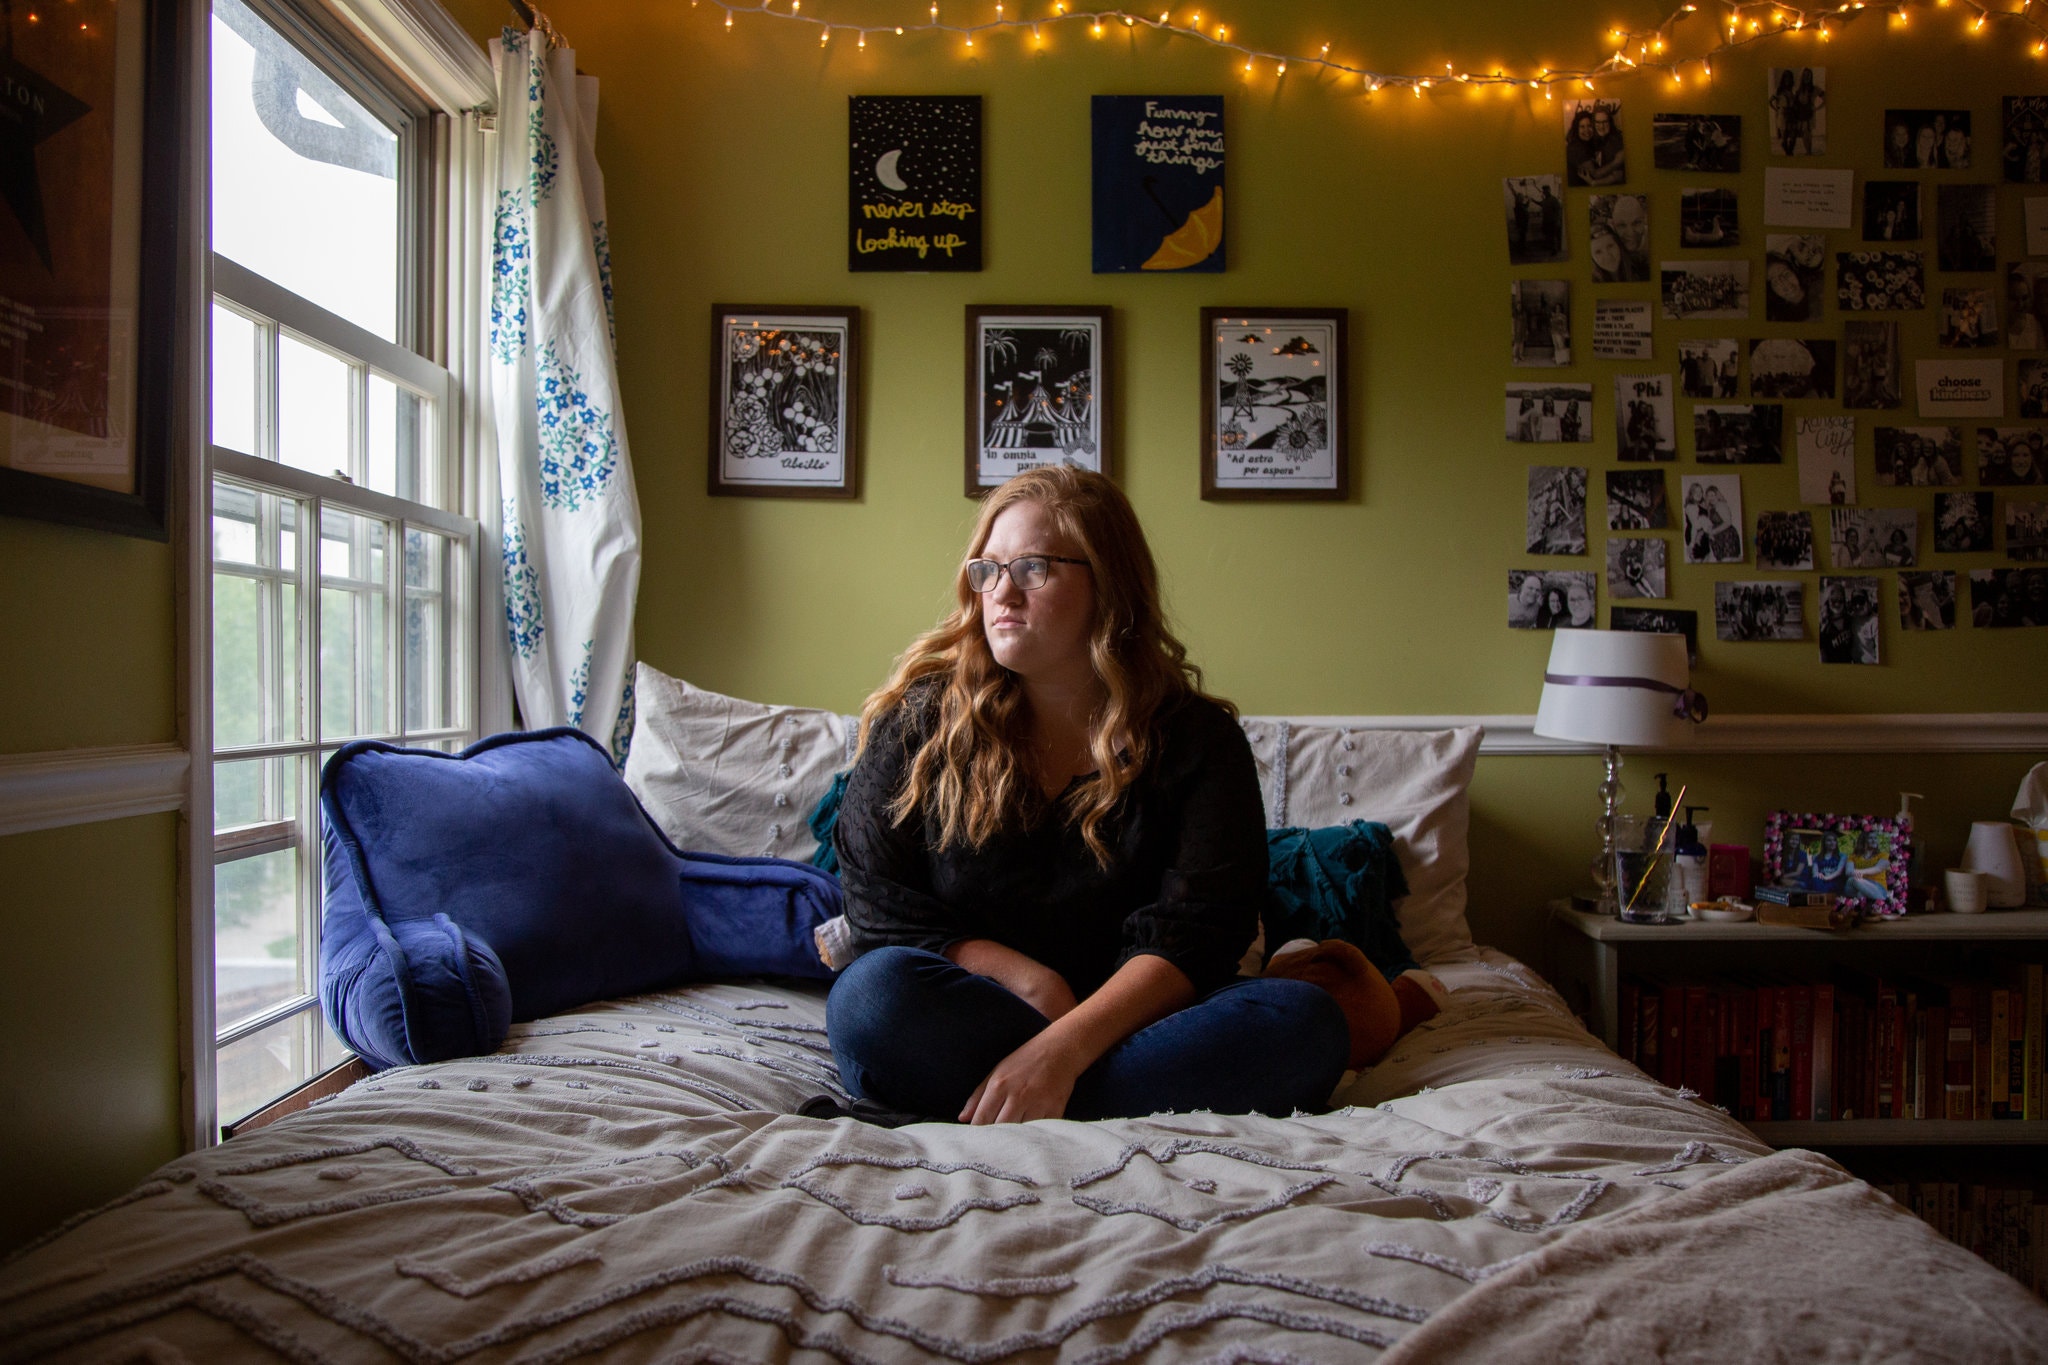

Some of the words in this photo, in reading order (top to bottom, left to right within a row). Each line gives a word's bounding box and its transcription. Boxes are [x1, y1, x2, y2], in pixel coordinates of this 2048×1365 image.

[1145, 101, 1218, 127] Funny
[1136, 121, 1185, 139] how
[1185, 127, 1223, 143] you
[1133, 136, 1179, 156] just
[1179, 138, 1224, 155] find
[1145, 151, 1224, 175] things
[862, 201, 925, 219] never
[930, 200, 975, 221] stop
[857, 227, 929, 260] looking
[933, 233, 967, 258] up
[1633, 381, 1662, 397] Phi
[1938, 376, 1981, 387] choose
[1930, 387, 1992, 401] kindness
[1003, 450, 1036, 460] omnia
[1248, 454, 1274, 464] astra
[1244, 466, 1259, 476] per
[2011, 1048, 2022, 1087] PARIS
